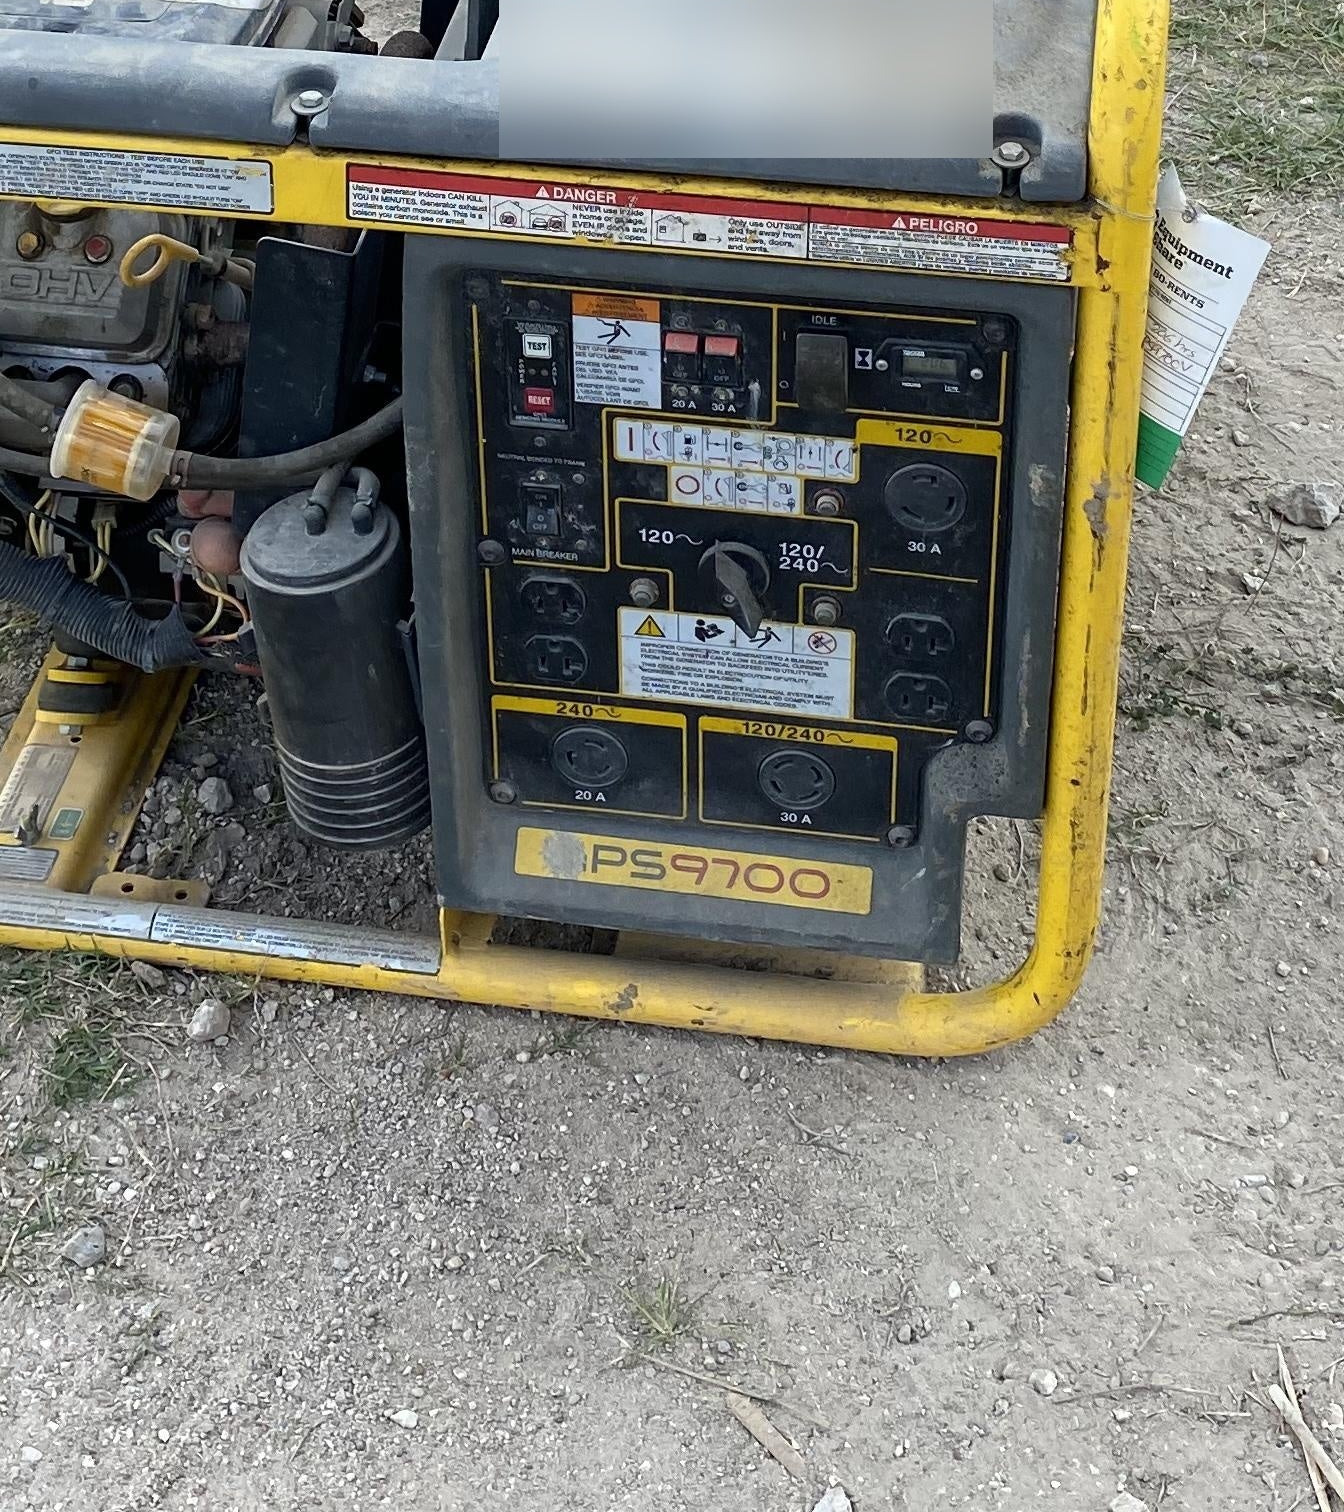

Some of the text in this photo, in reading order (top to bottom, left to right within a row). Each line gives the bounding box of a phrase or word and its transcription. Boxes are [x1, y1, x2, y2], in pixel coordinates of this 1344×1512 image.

[351, 183, 373, 193] Using
[381, 187, 417, 197] generator
[447, 193, 465, 201] CAN
[466, 194, 484, 203] KILL
[553, 187, 617, 204] DANGER
[352, 192, 369, 201] YOU
[419, 199, 456, 209] Generator
[458, 203, 487, 212] exhaust
[572, 203, 601, 213] NEVER
[352, 201, 383, 210] contains
[385, 204, 411, 212] carbon
[452, 210, 468, 218] This
[352, 209, 377, 217] poison
[394, 213, 419, 221] cannot
[579, 213, 602, 221] home
[728, 218, 747, 228] Only
[572, 221, 595, 229] EVEN
[909, 216, 978, 235] PELIGRO
[728, 235, 766, 246] windws,
[758, 229, 781, 238] away
[782, 231, 802, 239] from
[1158, 217, 1235, 280] Equipment
[5, 265, 116, 302] OHV
[811, 315, 837, 326] IDLE
[527, 341, 546, 351] TEST
[527, 395, 551, 406] RESET
[672, 399, 697, 409] 20 A
[711, 402, 736, 413] 30 A
[511, 547, 578, 561] MAIN BREAKER
[778, 542, 824, 561] 120/
[908, 540, 942, 555] 30 A
[741, 721, 826, 743] 120/240
[575, 790, 607, 803] 20 A
[780, 812, 812, 825] 30 A
[583, 843, 832, 900] PS9700
